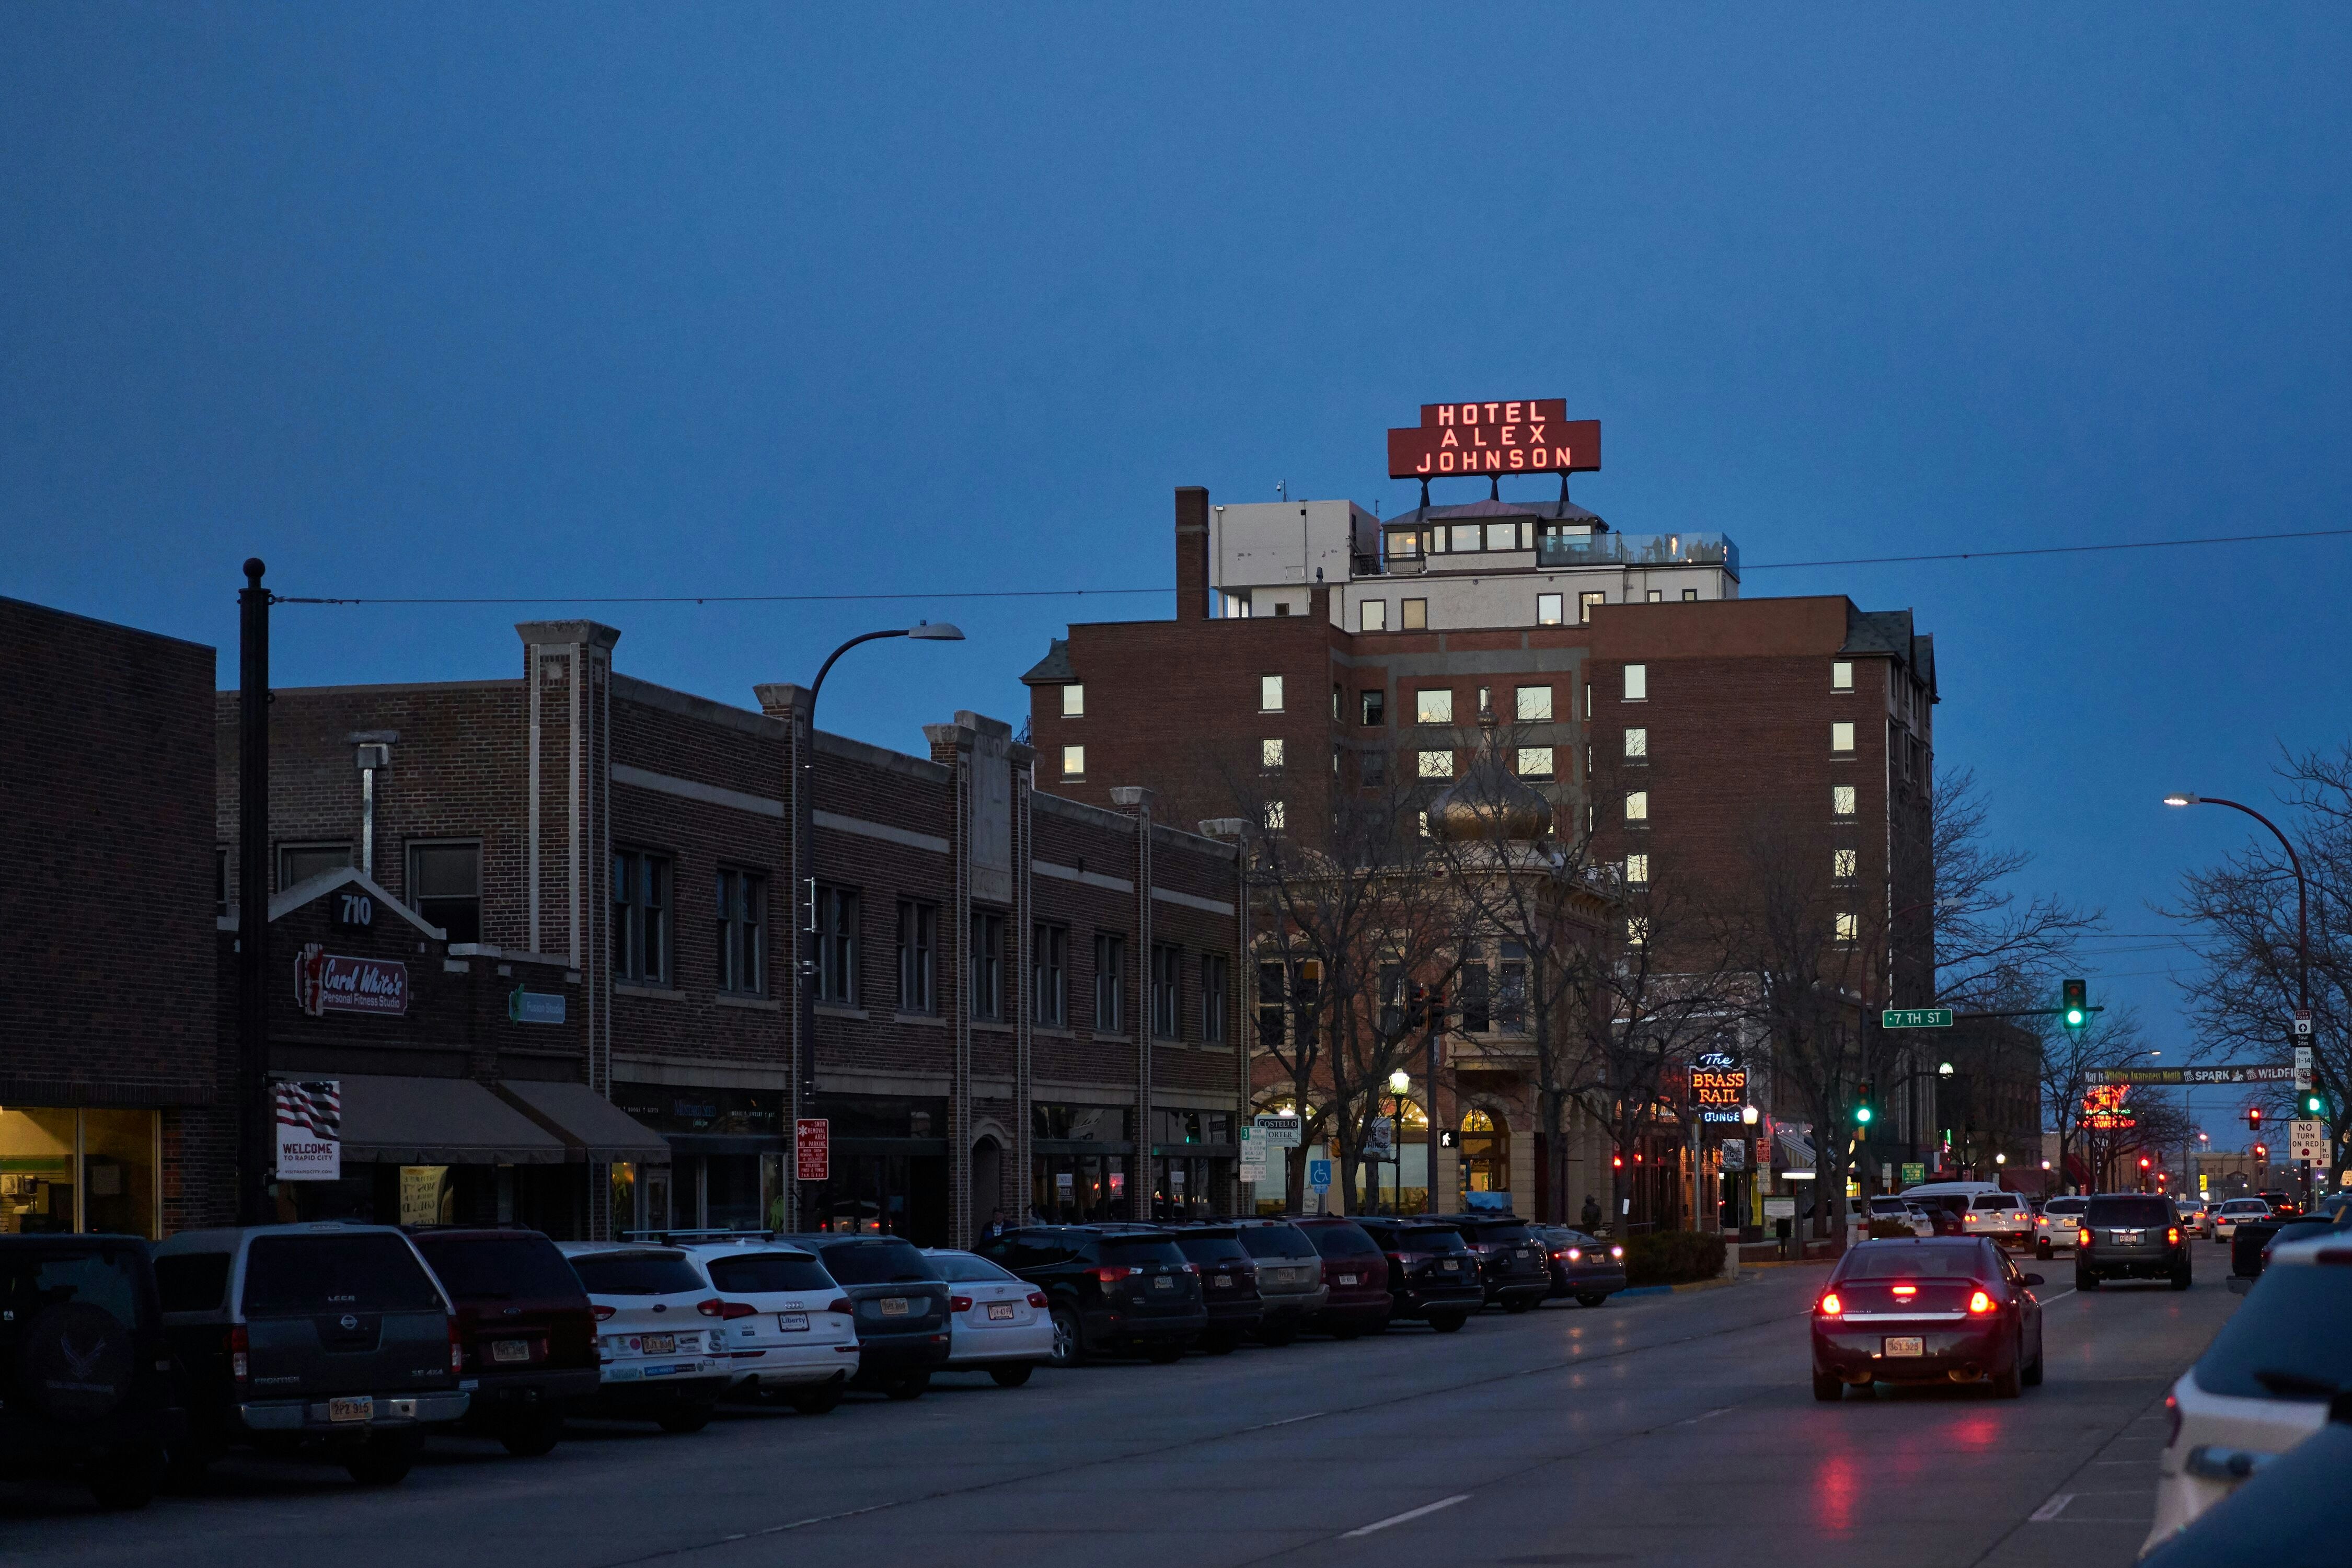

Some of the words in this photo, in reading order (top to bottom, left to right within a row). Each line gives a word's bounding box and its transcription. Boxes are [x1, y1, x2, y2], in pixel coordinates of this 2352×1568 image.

[1438, 401, 1546, 426] HOTEL
[1440, 424, 1546, 447] ALEX
[1416, 447, 1571, 473] JOHNSON
[341, 894, 371, 925] 710
[324, 959, 360, 991] Carol
[360, 964, 402, 996] White's
[323, 990, 352, 1004] Personal
[354, 993, 377, 1007] Fitness
[379, 995, 400, 1008] Studio
[1894, 1013, 1901, 1024] 7
[1906, 1012, 1921, 1024] TH
[1927, 1012, 1941, 1024] ST
[1700, 1053, 1734, 1065] The
[2085, 1071, 2096, 1083] May
[2099, 1071, 2103, 1082] is
[2104, 1070, 2129, 1082] Wildfire
[2130, 1070, 2161, 1081] Awareness
[2163, 1070, 2181, 1081] Month
[2195, 1070, 2229, 1081] SPARK
[2258, 1067, 2296, 1079] WILDFI
[1693, 1073, 1745, 1087] BRASS
[1699, 1089, 1739, 1103] RAIL
[1698, 1112, 1740, 1122] OUNGE
[1259, 1120, 1297, 1128] COSTELLO
[1243, 1128, 1248, 1139] 3
[283, 1143, 332, 1154] WELCOME
[255, 1376, 301, 1385] FRONTIER
[334, 1404, 350, 1414] 2P2
[353, 1403, 369, 1413] 915
